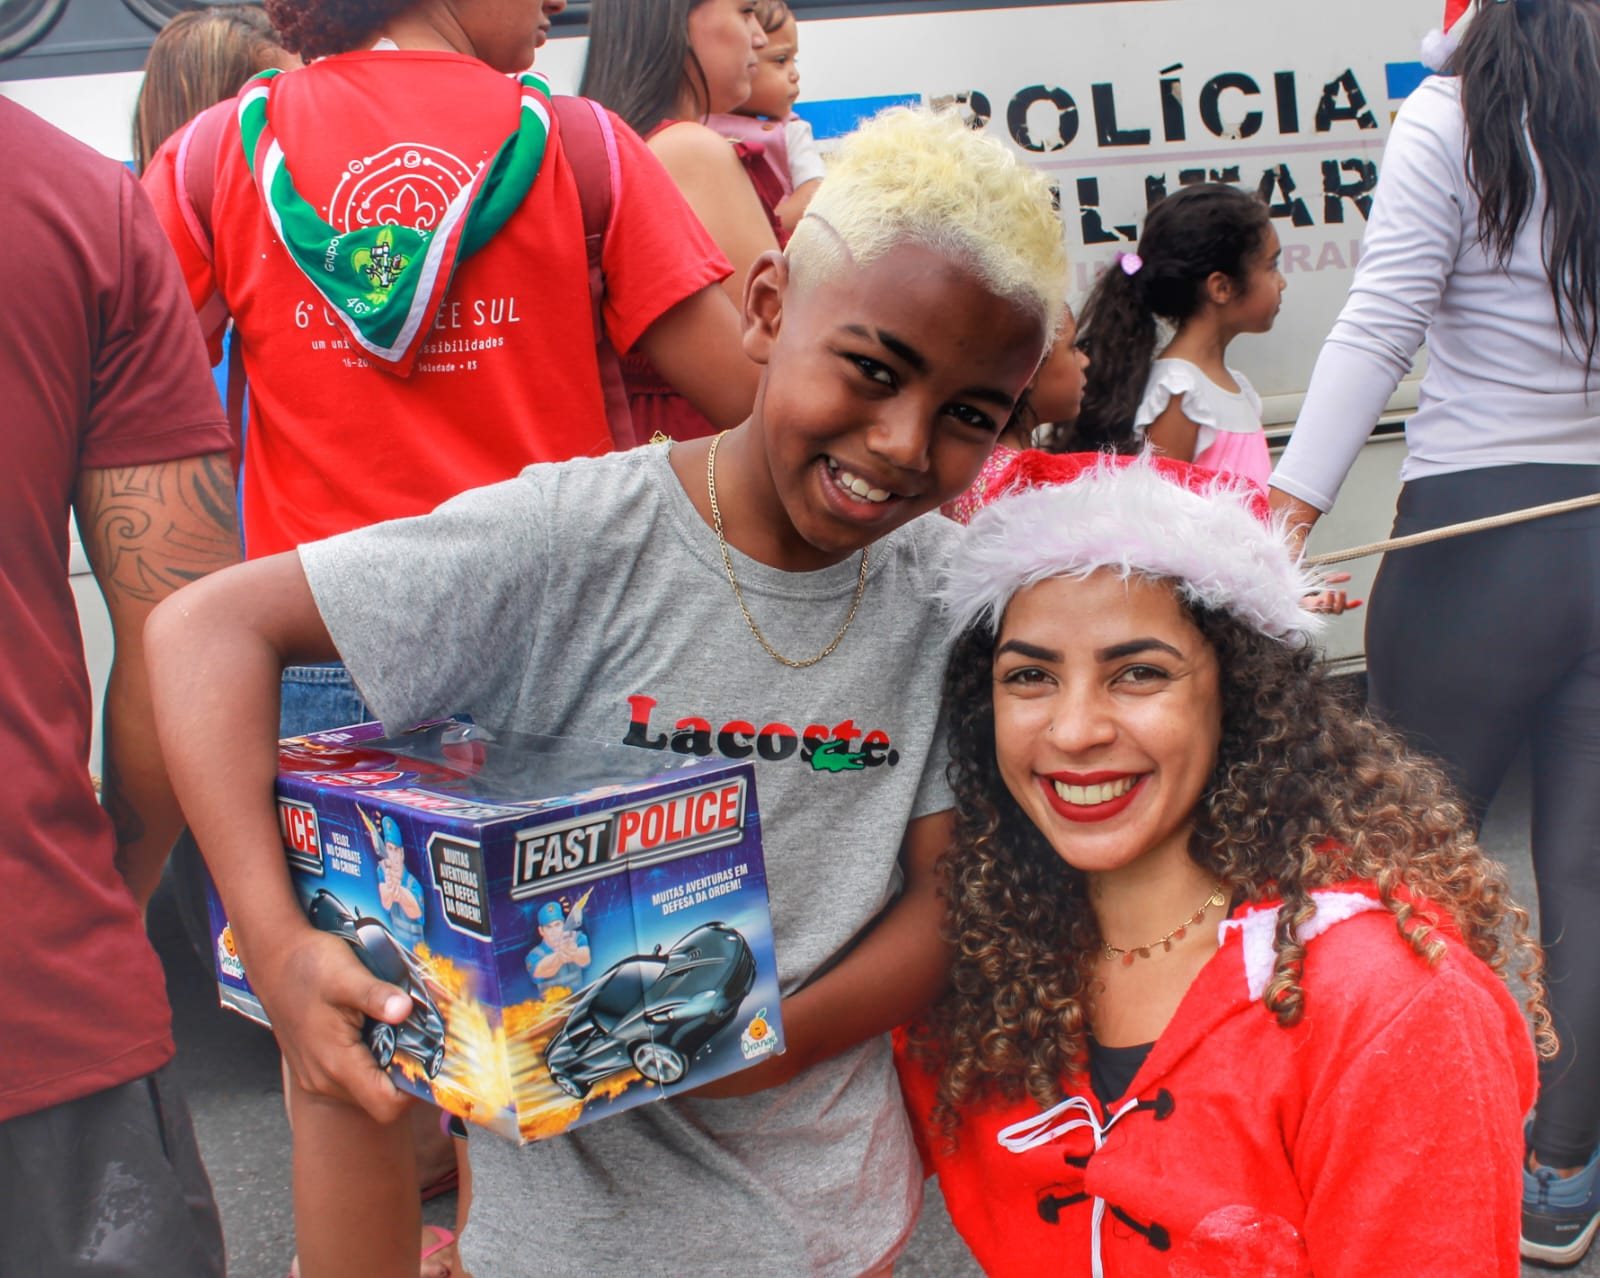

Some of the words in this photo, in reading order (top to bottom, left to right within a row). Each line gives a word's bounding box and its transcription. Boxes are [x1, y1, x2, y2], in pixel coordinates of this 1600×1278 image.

[1049, 158, 1377, 245] LITAR
[473, 297, 521, 326] SUL
[311, 340, 326, 350] um
[419, 336, 504, 354] ssibilidades
[283, 804, 319, 855] ICE
[523, 822, 607, 882] FAST
[616, 785, 739, 855] POLICE
[334, 845, 362, 865] COMBATE
[443, 847, 470, 869] MUITAS
[440, 863, 479, 889] AVENTURAS
[652, 884, 685, 907] MUITAS
[685, 869, 734, 895] AVENTURAS
[734, 863, 748, 878] EM
[443, 880, 455, 898] EM
[454, 883, 480, 907] DEFESA
[662, 894, 695, 916] DEFESA
[695, 890, 708, 904] DA
[708, 878, 742, 899] ORDEM!
[445, 897, 457, 914] DA
[455, 900, 482, 924] ORDEM!
